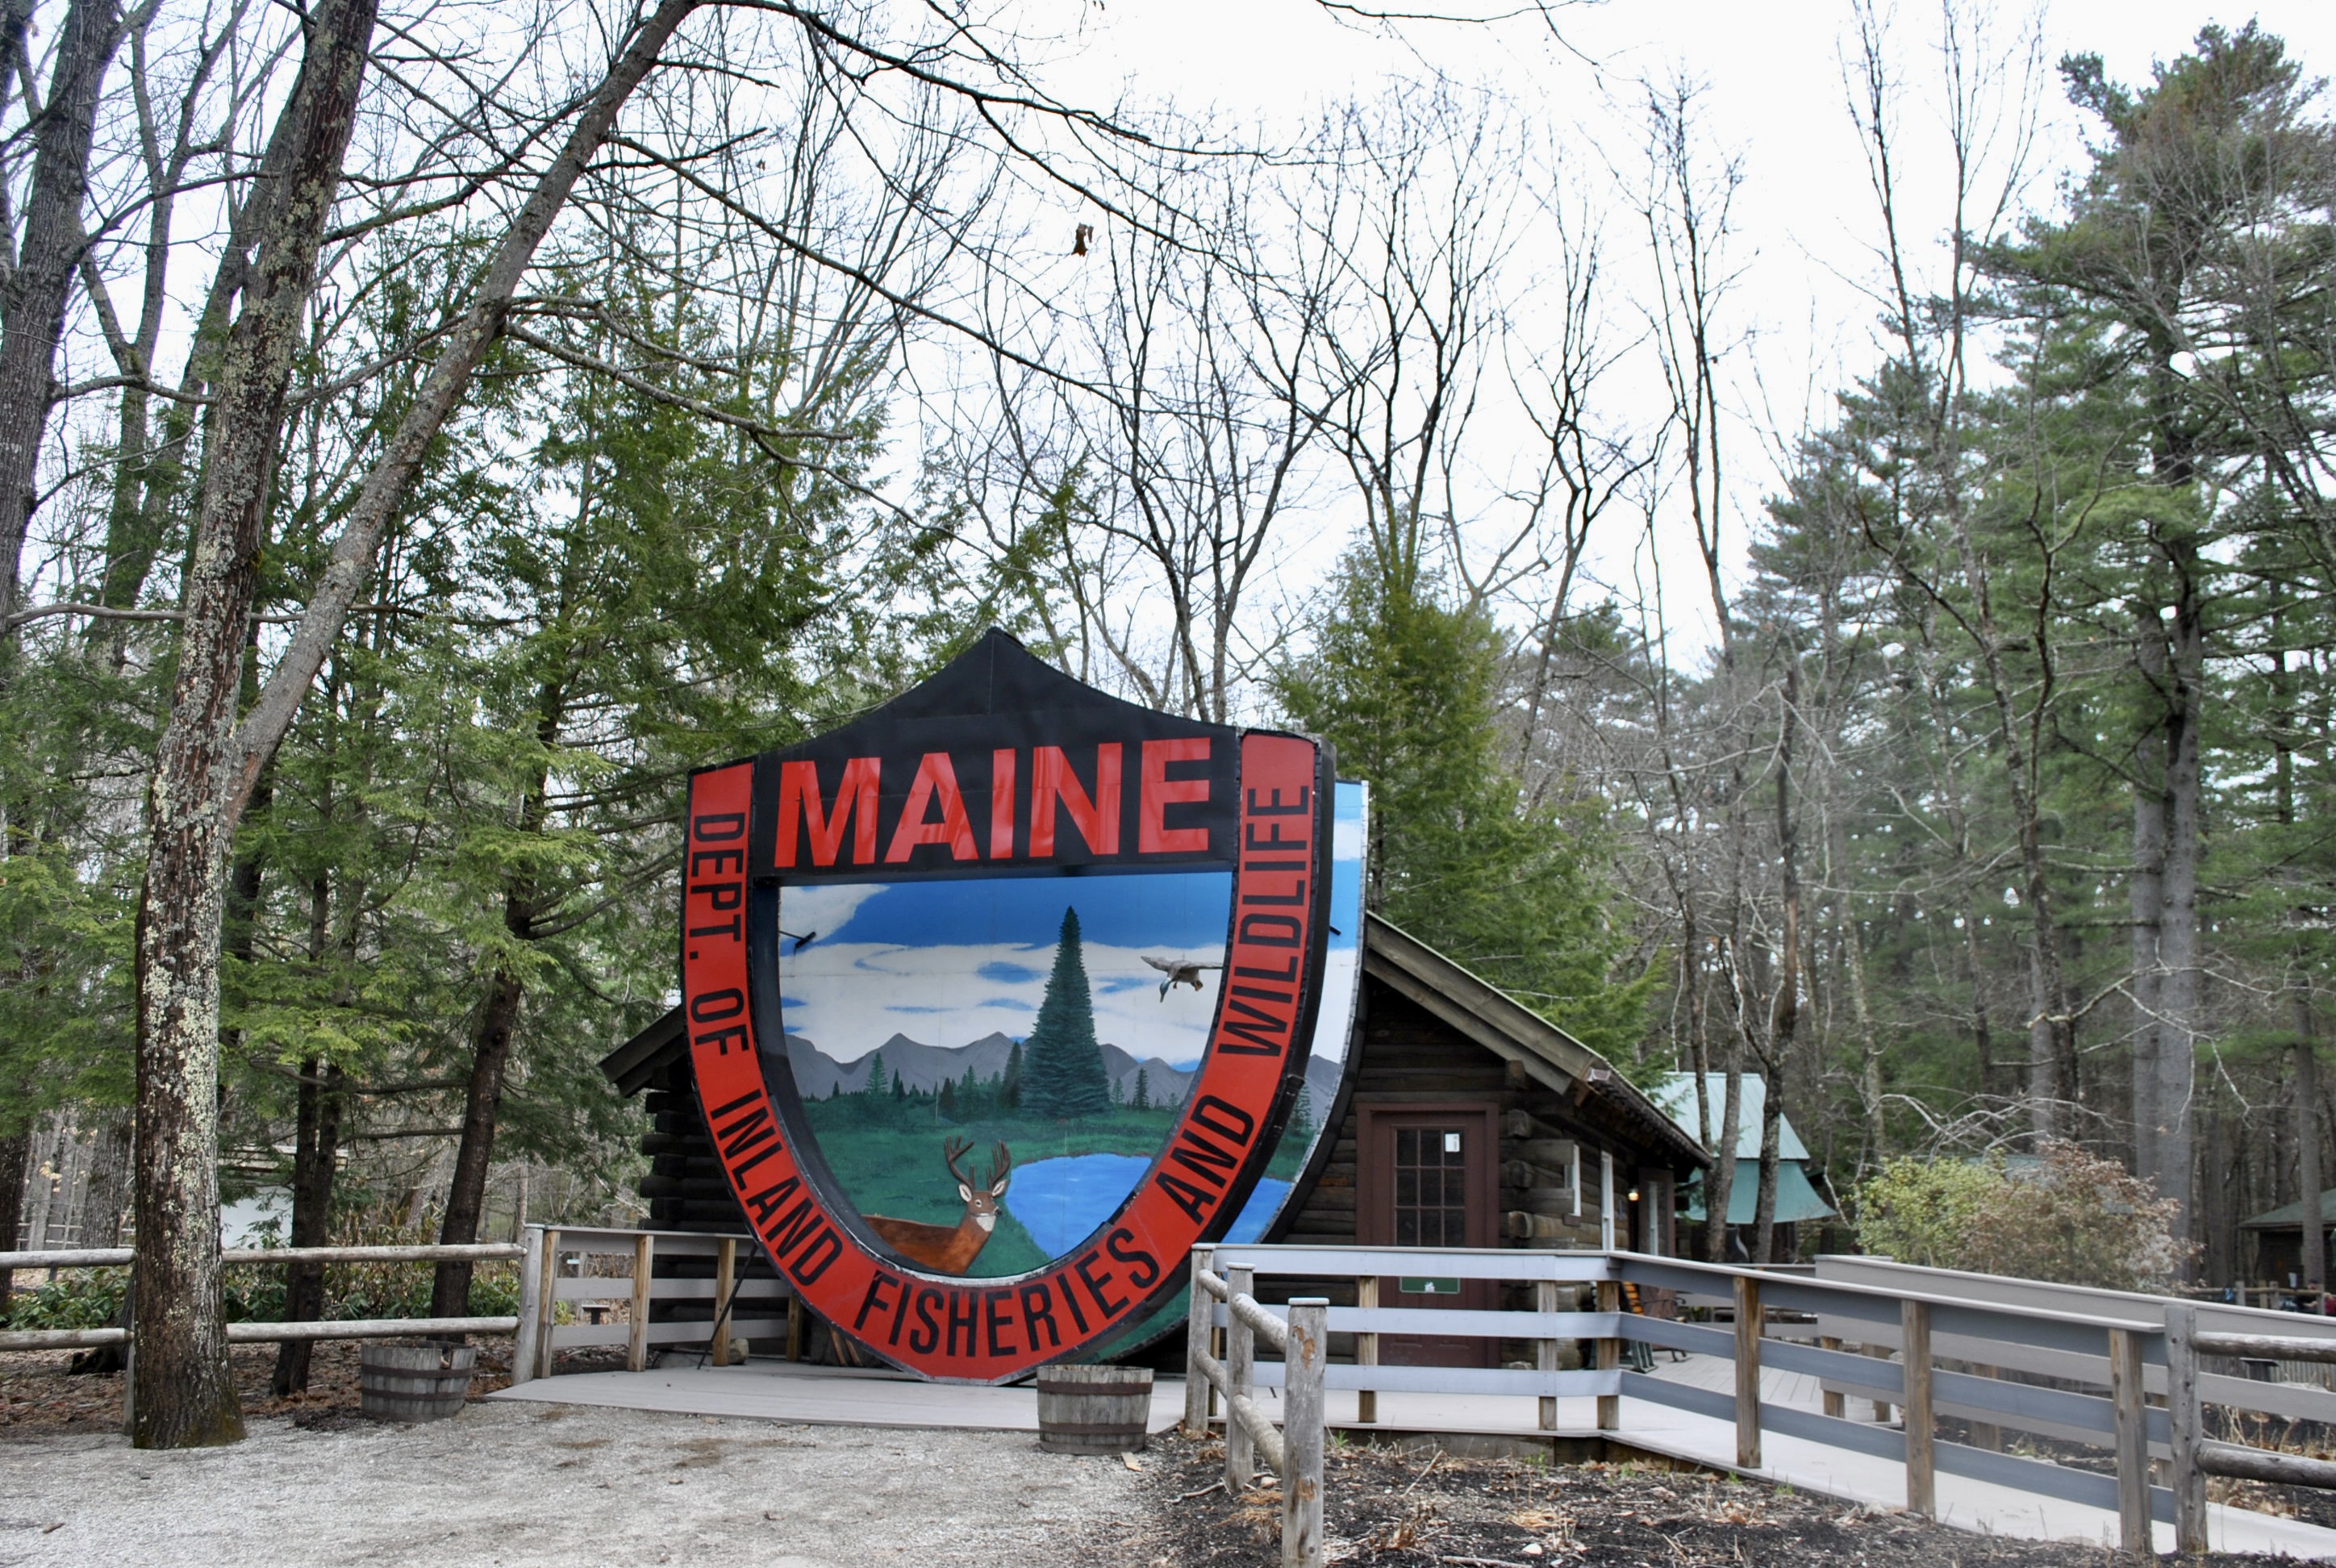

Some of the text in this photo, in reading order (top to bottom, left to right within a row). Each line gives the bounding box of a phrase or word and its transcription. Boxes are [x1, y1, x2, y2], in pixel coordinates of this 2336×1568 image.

[774, 737, 1212, 868] MAINE
[690, 786, 1308, 1357] DEPT. OF INLAND FISHERIES AND WILDLIFE
